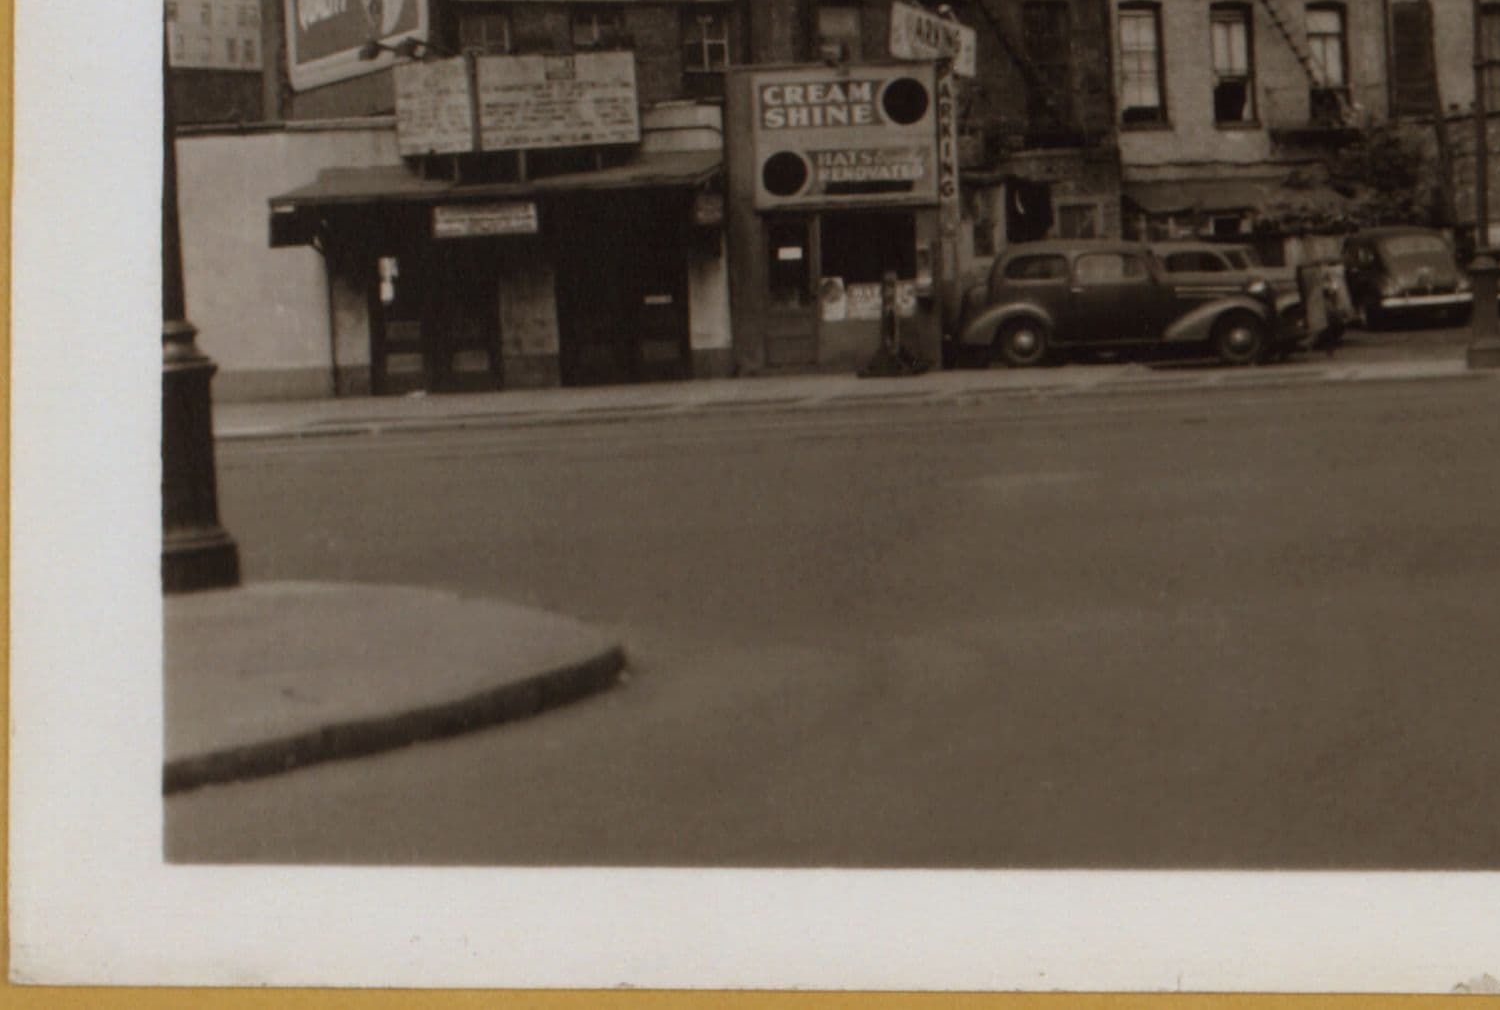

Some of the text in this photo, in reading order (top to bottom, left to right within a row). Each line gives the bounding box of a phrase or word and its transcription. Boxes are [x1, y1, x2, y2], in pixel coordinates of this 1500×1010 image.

[763, 82, 872, 105] CREAM
[764, 104, 873, 129] SHINE
[817, 151, 873, 167] HATS
[817, 164, 925, 182] RENOVATED
